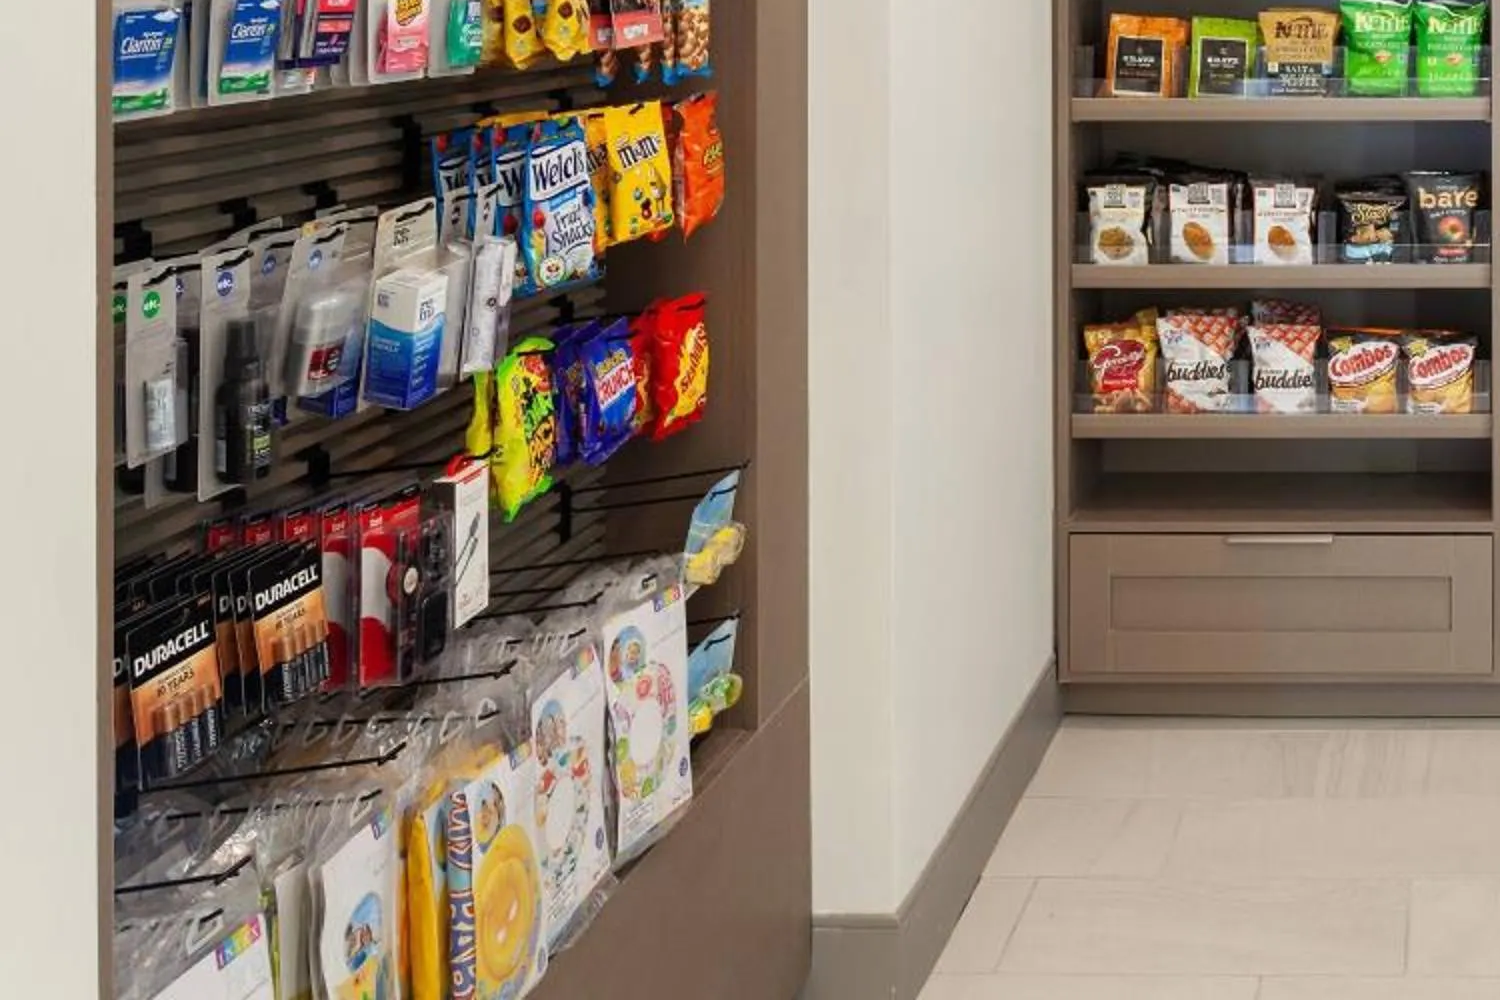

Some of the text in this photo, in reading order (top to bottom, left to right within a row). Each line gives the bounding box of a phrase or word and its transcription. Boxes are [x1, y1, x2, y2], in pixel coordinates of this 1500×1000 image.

[1417, 187, 1479, 209] bare
[1167, 360, 1225, 382] buddies
[1330, 343, 1393, 377] Combos
[1410, 345, 1471, 378] Combos
[255, 565, 319, 611] DURACELL
[133, 621, 209, 677] DURACELL
